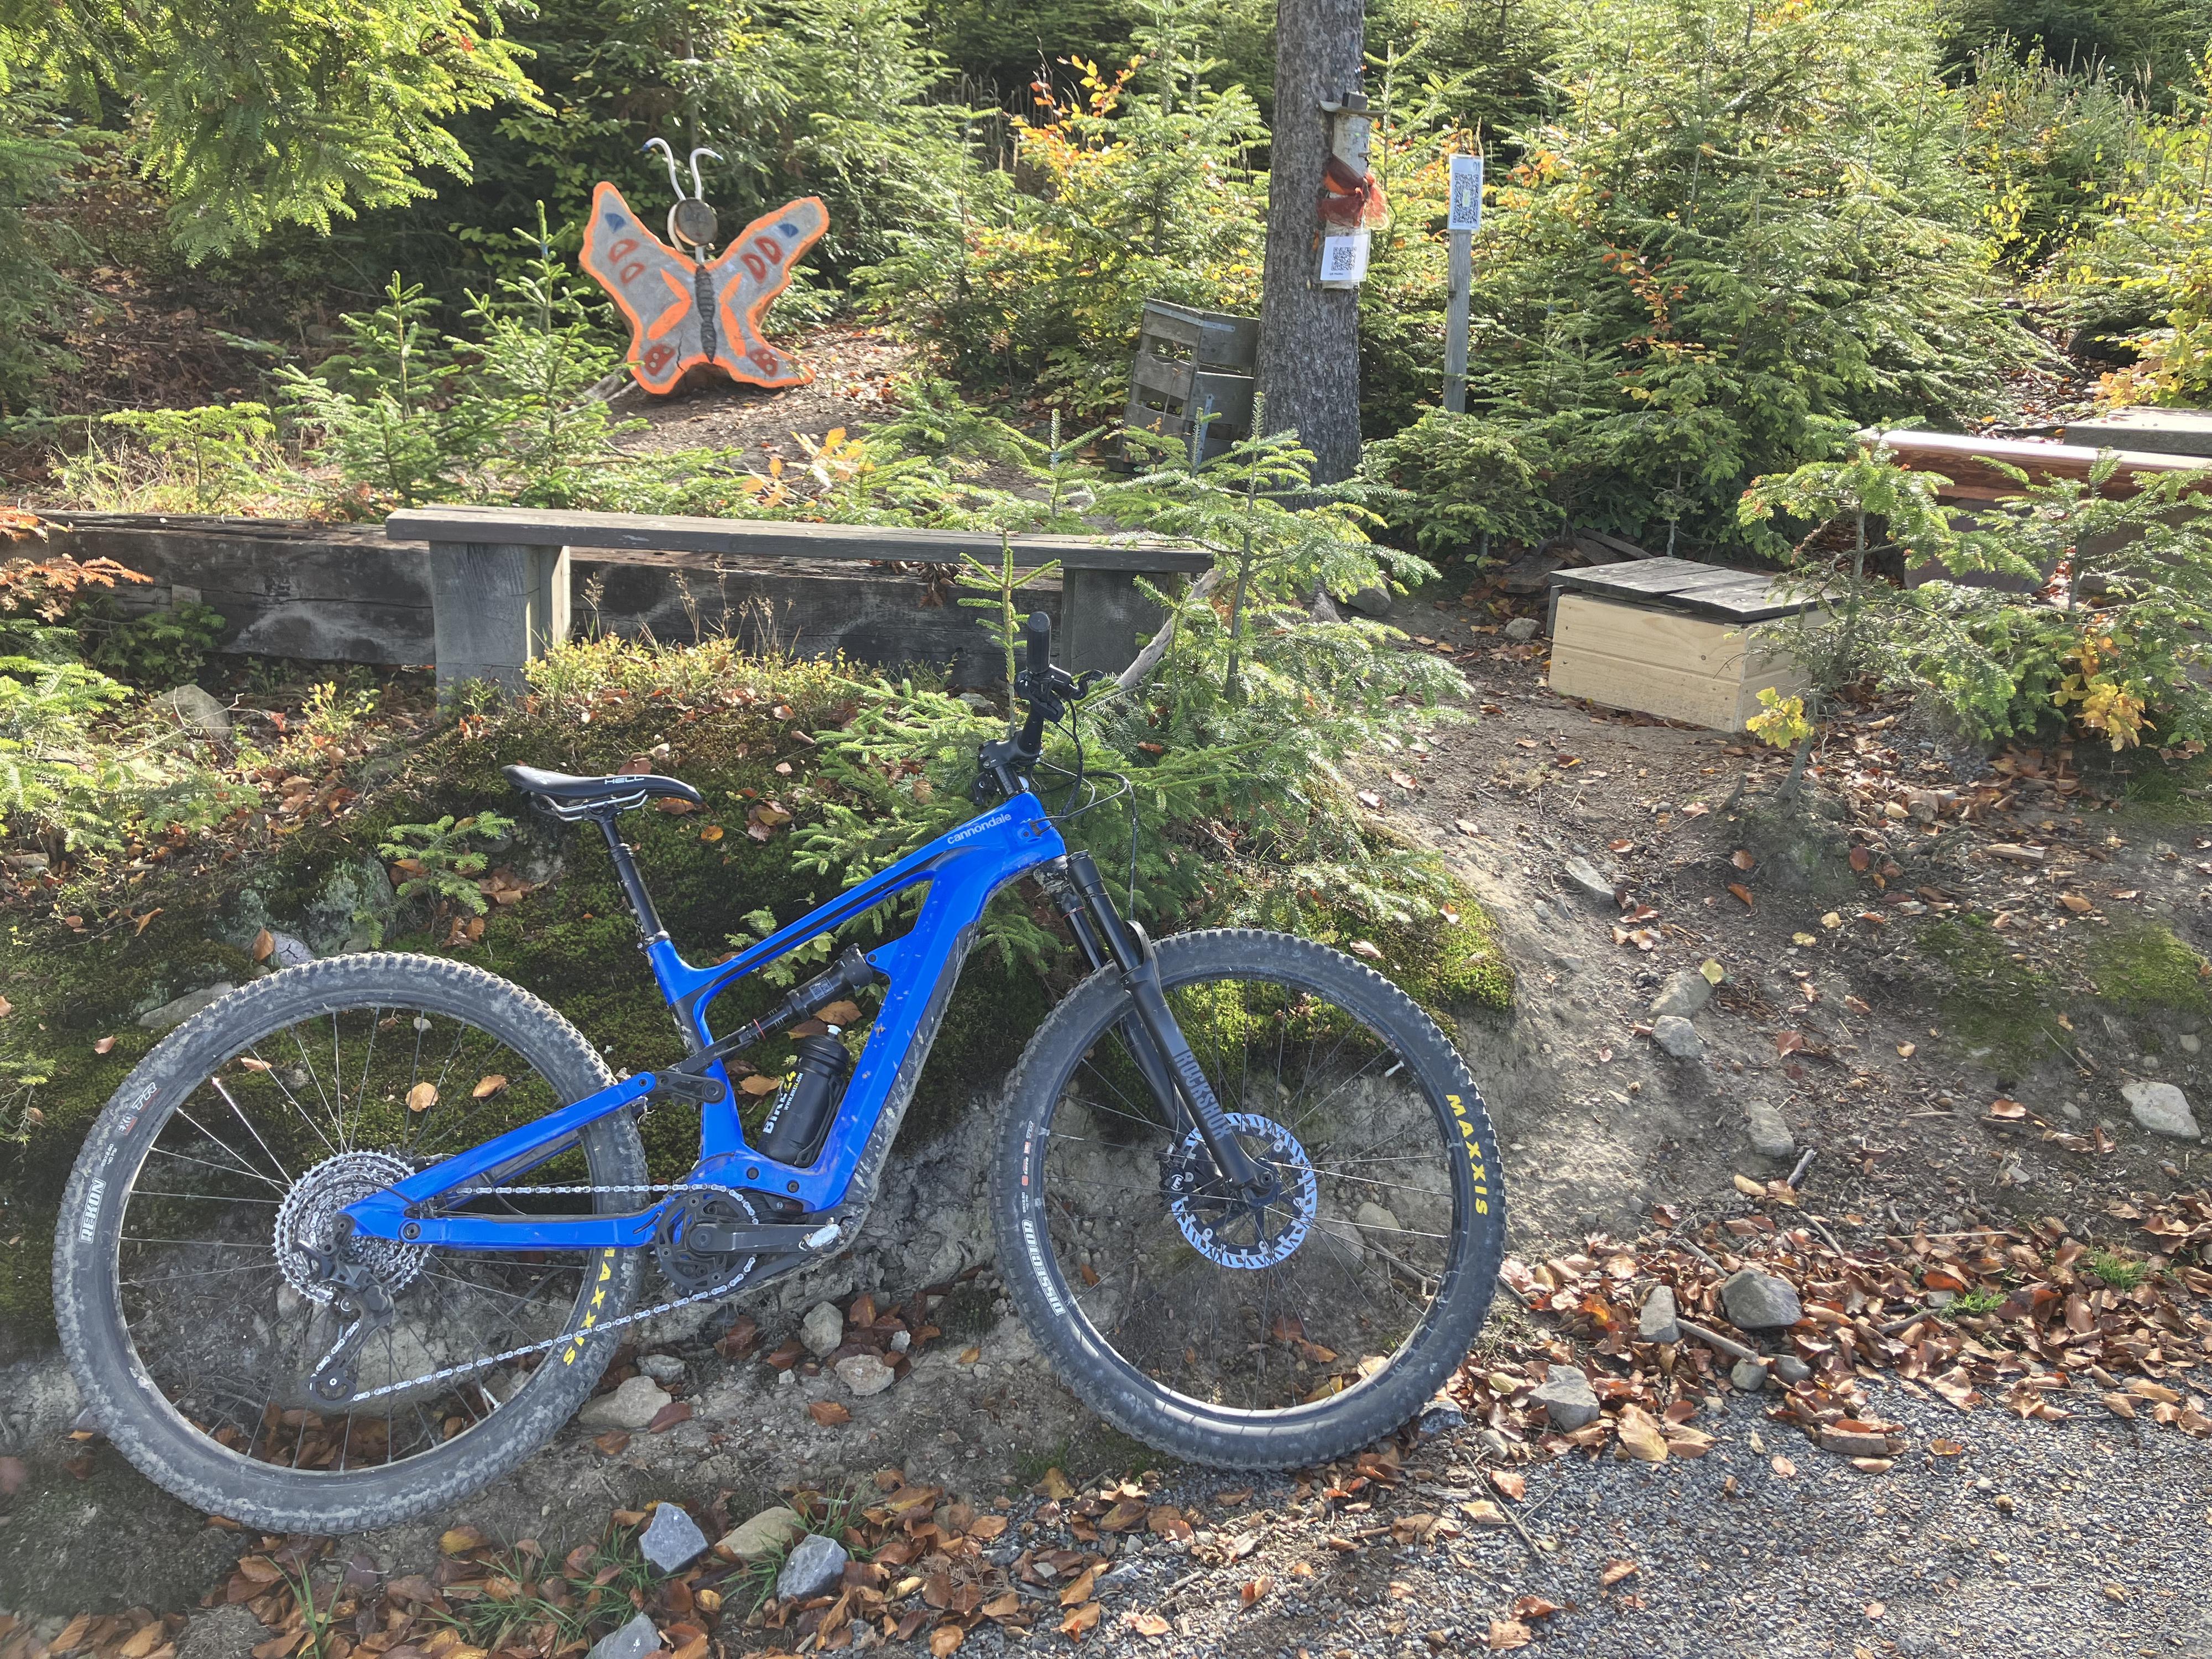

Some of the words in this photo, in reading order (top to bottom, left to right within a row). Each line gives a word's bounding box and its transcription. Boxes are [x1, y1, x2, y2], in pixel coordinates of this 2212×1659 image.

[604, 776, 645, 785] HELL
[947, 813, 1012, 844] cannondale
[132, 1082, 158, 1111] TR
[1173, 1051, 1233, 1141] ROCKSHOX
[1445, 1094, 1488, 1215] MAXXIS
[79, 1177, 106, 1244] REKON
[1022, 1219, 1066, 1316] DISSECTOR
